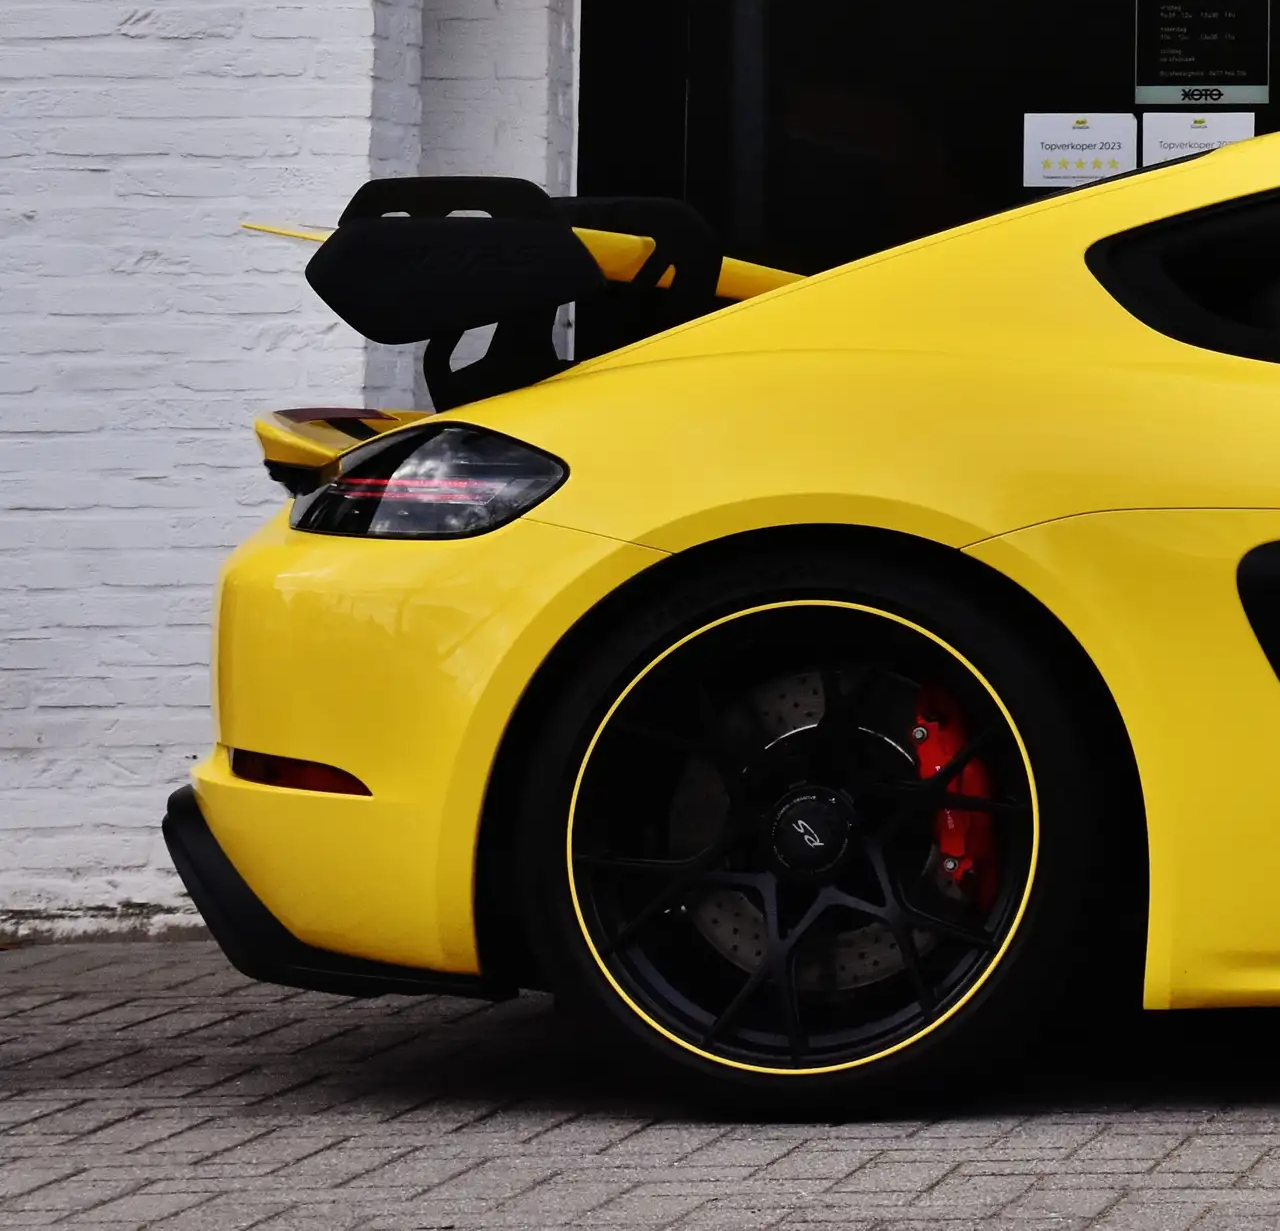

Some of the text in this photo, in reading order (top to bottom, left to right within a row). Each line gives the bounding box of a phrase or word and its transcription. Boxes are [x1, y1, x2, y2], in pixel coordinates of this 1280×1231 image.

[1040, 141, 1122, 152] Topverkoper 2023
[792, 820, 824, 848] RS
